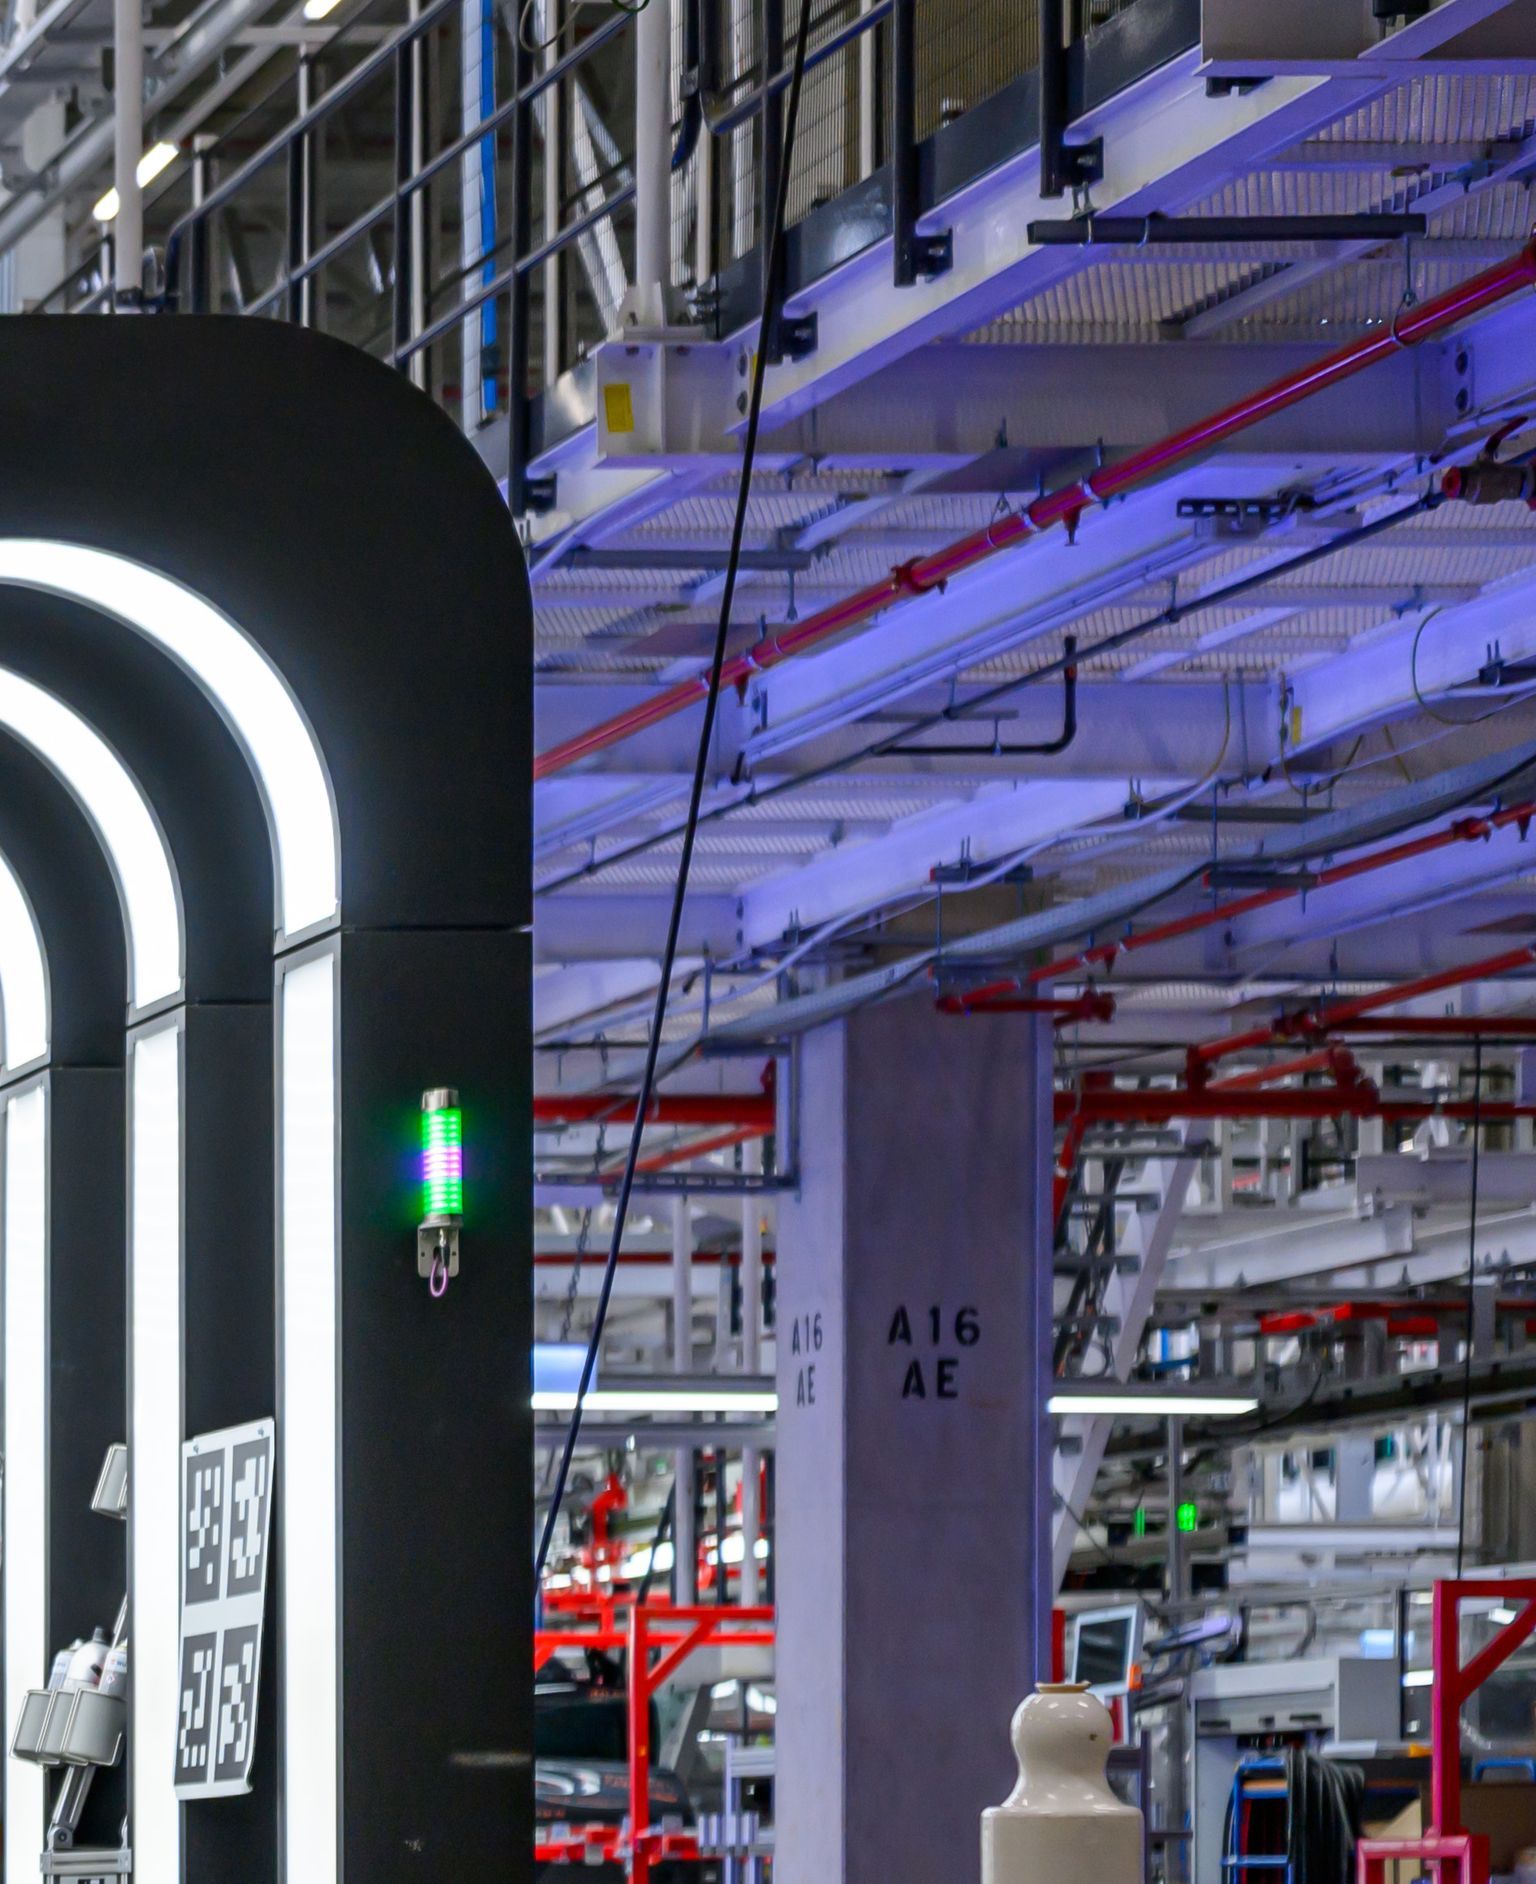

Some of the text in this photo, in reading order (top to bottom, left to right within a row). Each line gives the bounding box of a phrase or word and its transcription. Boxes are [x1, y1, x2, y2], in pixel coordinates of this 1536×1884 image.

[792, 1312, 823, 1356] A16
[888, 1305, 982, 1347] A16
[797, 1364, 816, 1408] AE
[902, 1358, 959, 1399] AE
